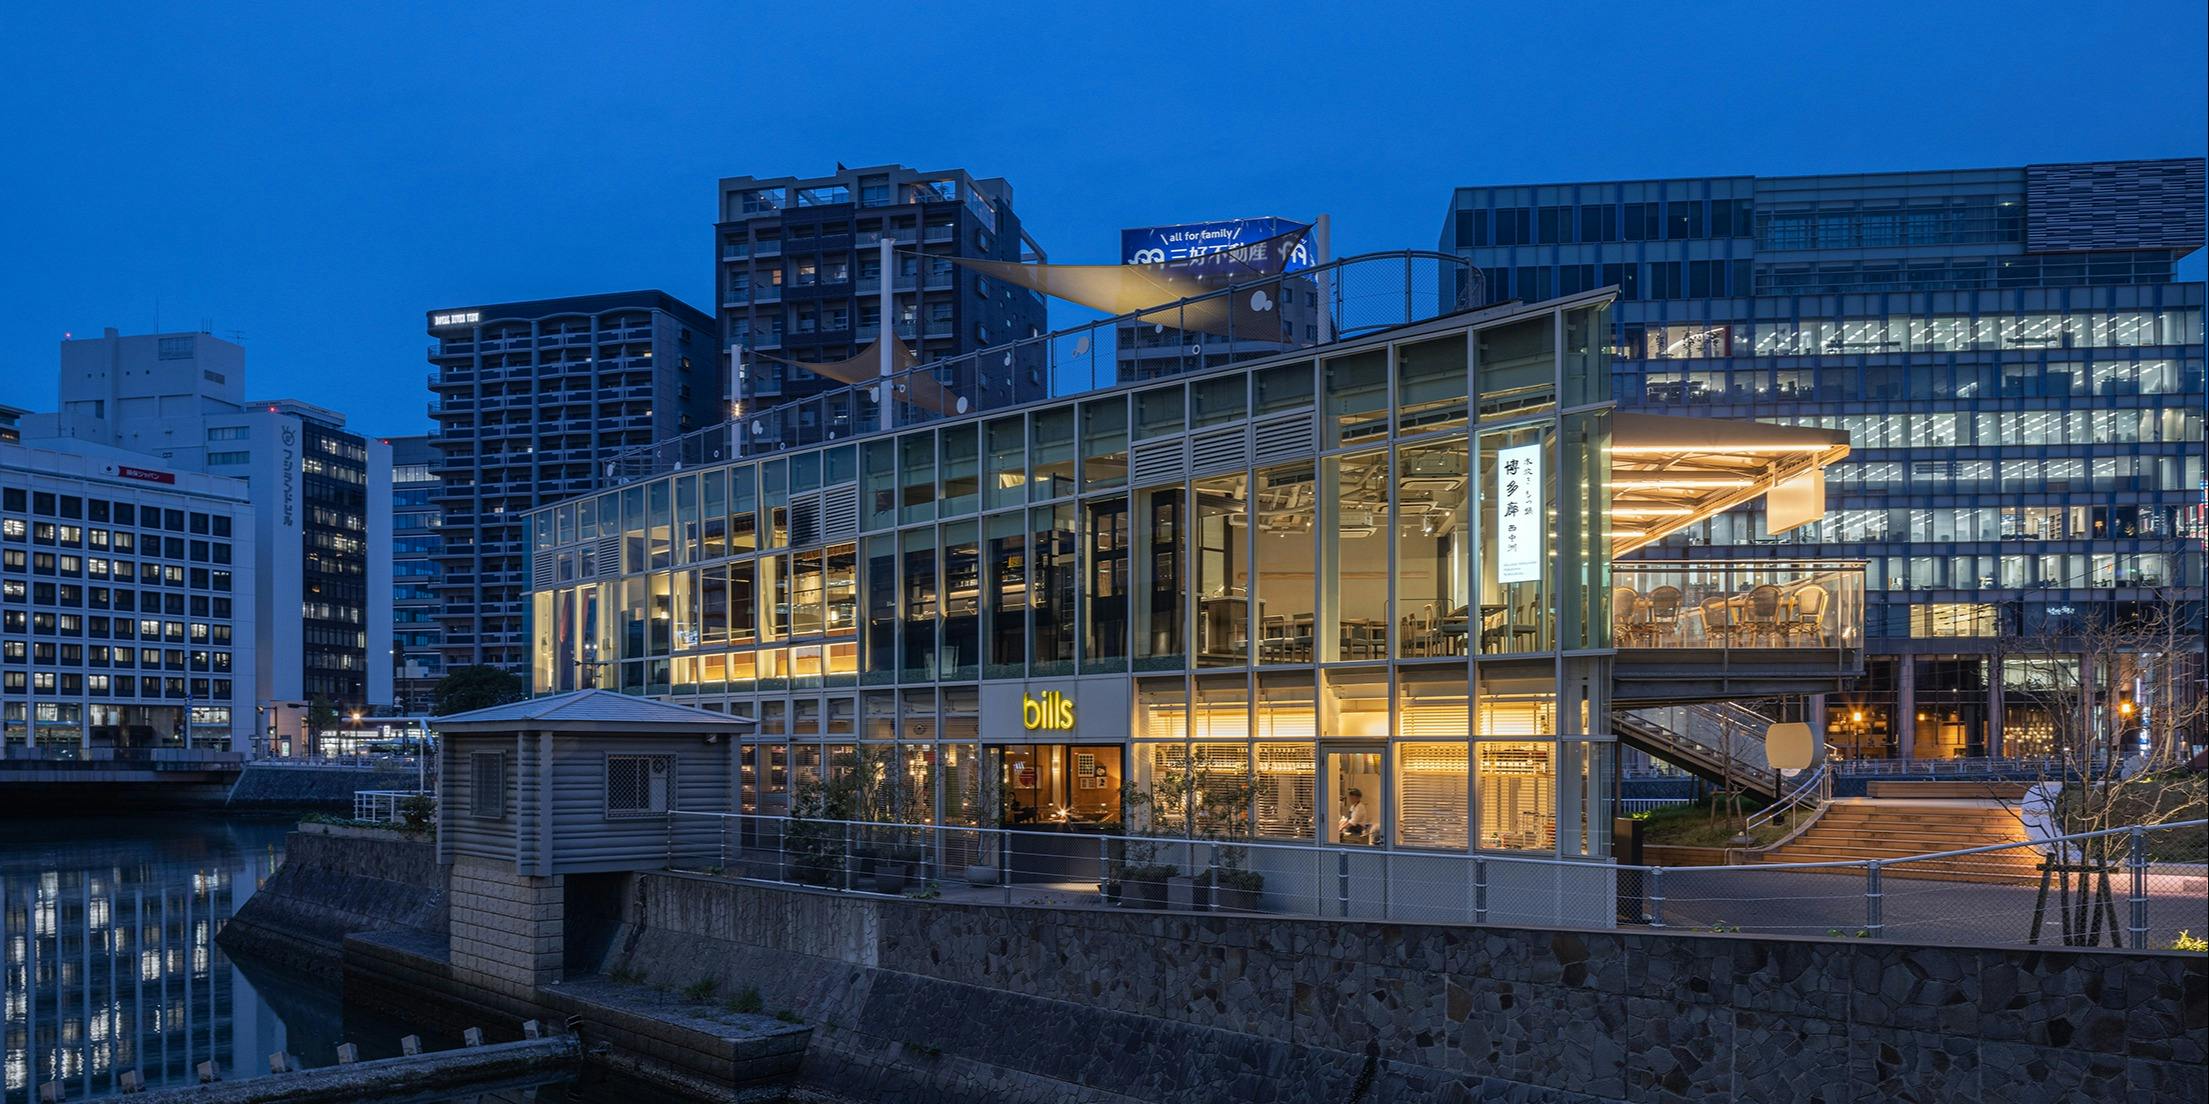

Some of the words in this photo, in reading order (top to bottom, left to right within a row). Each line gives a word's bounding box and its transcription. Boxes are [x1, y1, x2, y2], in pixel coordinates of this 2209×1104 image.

[1169, 230, 1183, 242] all
[1184, 230, 1200, 241] for
[1201, 228, 1234, 242] family
[1169, 242, 1268, 268] 三好不動産
[1022, 689, 1076, 731] bills
